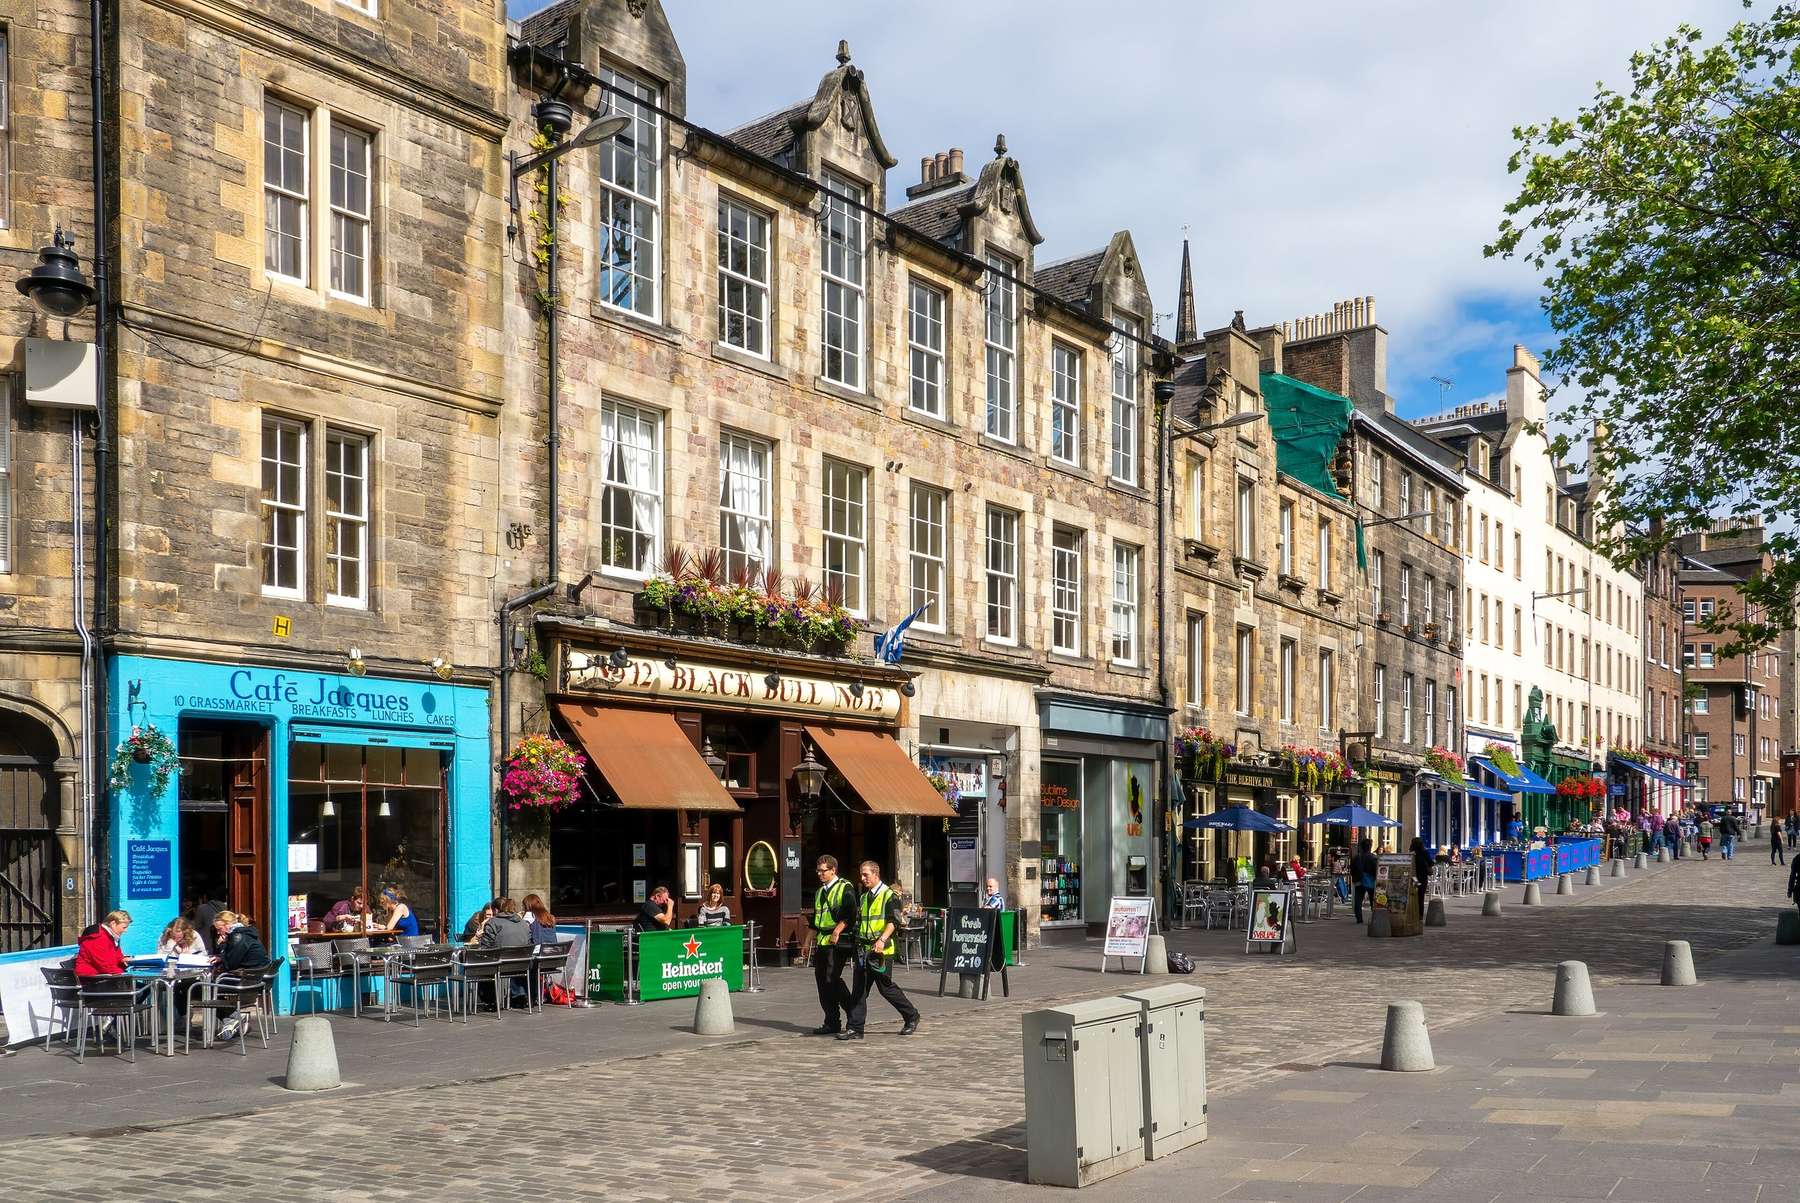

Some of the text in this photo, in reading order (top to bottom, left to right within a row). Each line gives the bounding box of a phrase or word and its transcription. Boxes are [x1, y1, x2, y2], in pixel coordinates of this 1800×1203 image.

[275, 617, 289, 636] H
[230, 670, 409, 712] Café Jacques
[669, 666, 750, 697] BLACK
[763, 678, 824, 706] BULL
[865, 690, 884, 712] 12
[174, 695, 274, 713] 10 GRASSMARKET
[292, 703, 455, 726] BREAKFASTS LUNCHES CAKES
[1225, 773, 1238, 785] THE
[1263, 776, 1273, 788] INN
[1040, 783, 1068, 796] Sublime
[1057, 796, 1080, 812] Design
[146, 844, 168, 853] Jacques
[66, 877, 74, 890] 8
[961, 915, 982, 929] fresh
[961, 943, 979, 955] food
[661, 959, 723, 979] Heineken
[954, 955, 982, 968] 12-10
[662, 980, 701, 992] open your
